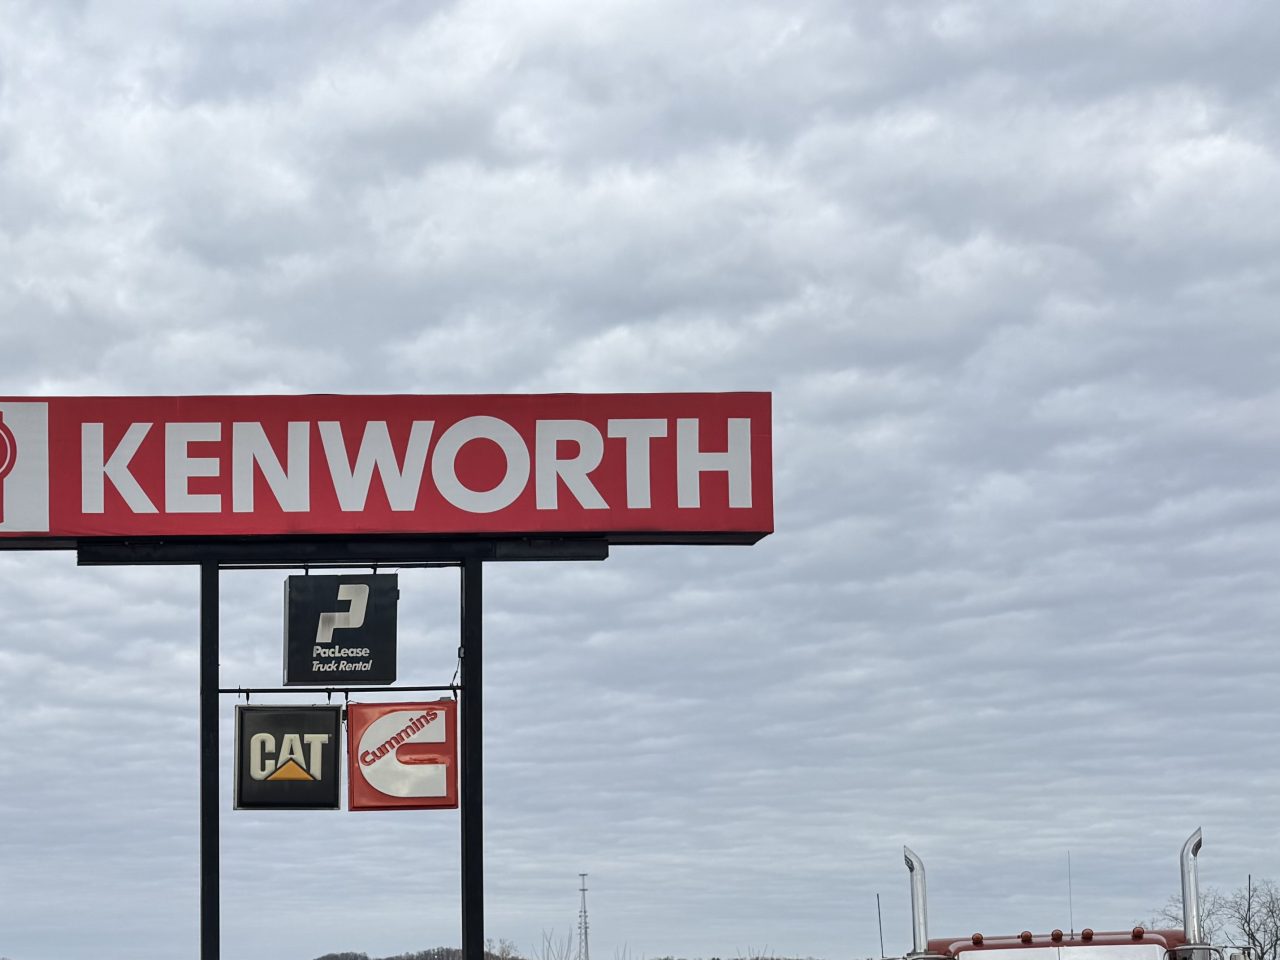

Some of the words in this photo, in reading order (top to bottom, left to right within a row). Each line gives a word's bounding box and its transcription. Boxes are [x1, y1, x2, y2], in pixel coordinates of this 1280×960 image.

[81, 414, 754, 514] KENWORTH
[311, 660, 338, 672] Truck
[338, 659, 373, 672] Rental
[312, 645, 370, 658] PacLease
[249, 732, 329, 781] CAT
[359, 709, 438, 767] Cummins
